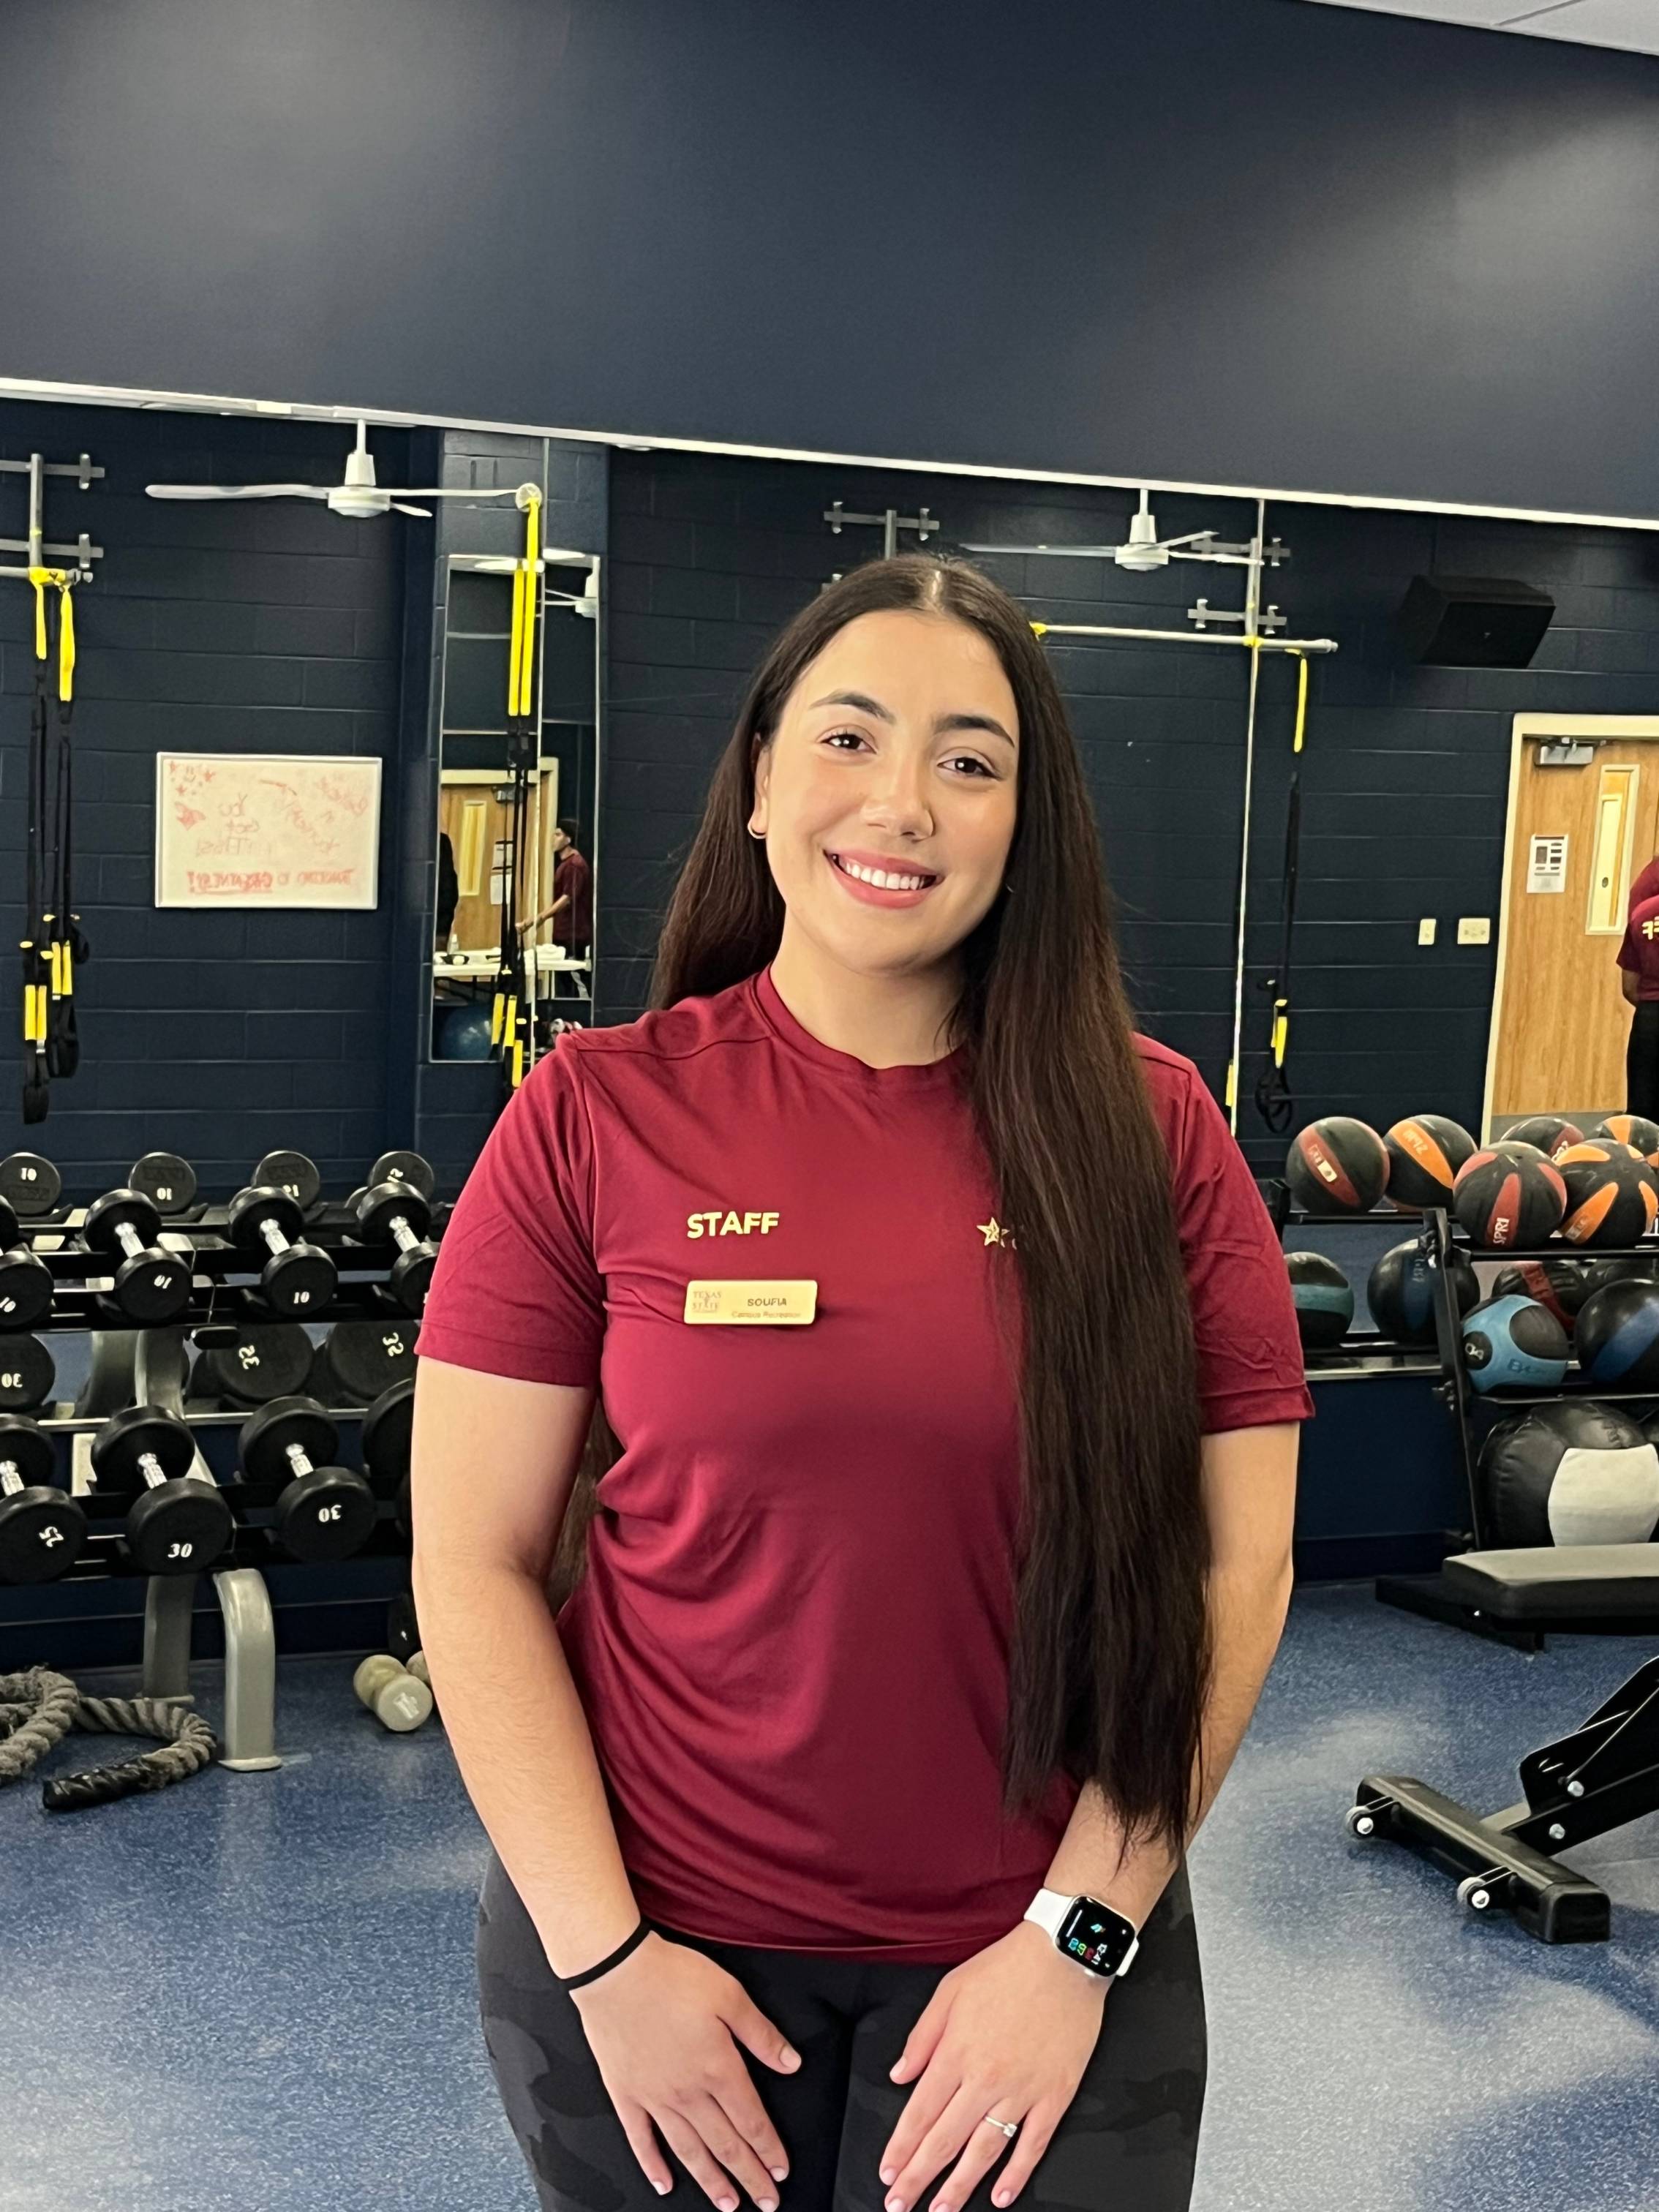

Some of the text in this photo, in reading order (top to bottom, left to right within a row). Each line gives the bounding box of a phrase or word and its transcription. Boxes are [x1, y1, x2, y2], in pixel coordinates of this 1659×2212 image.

[687, 1211, 780, 1238] STAFF
[1493, 1217, 1510, 1244] SPRI
[154, 1274, 172, 1289] 10
[0, 1297, 16, 1313] 10
[294, 1291, 310, 1304] 10
[318, 1504, 342, 1523] 30
[39, 1526, 64, 1547] 25
[168, 1543, 192, 1558] 30
